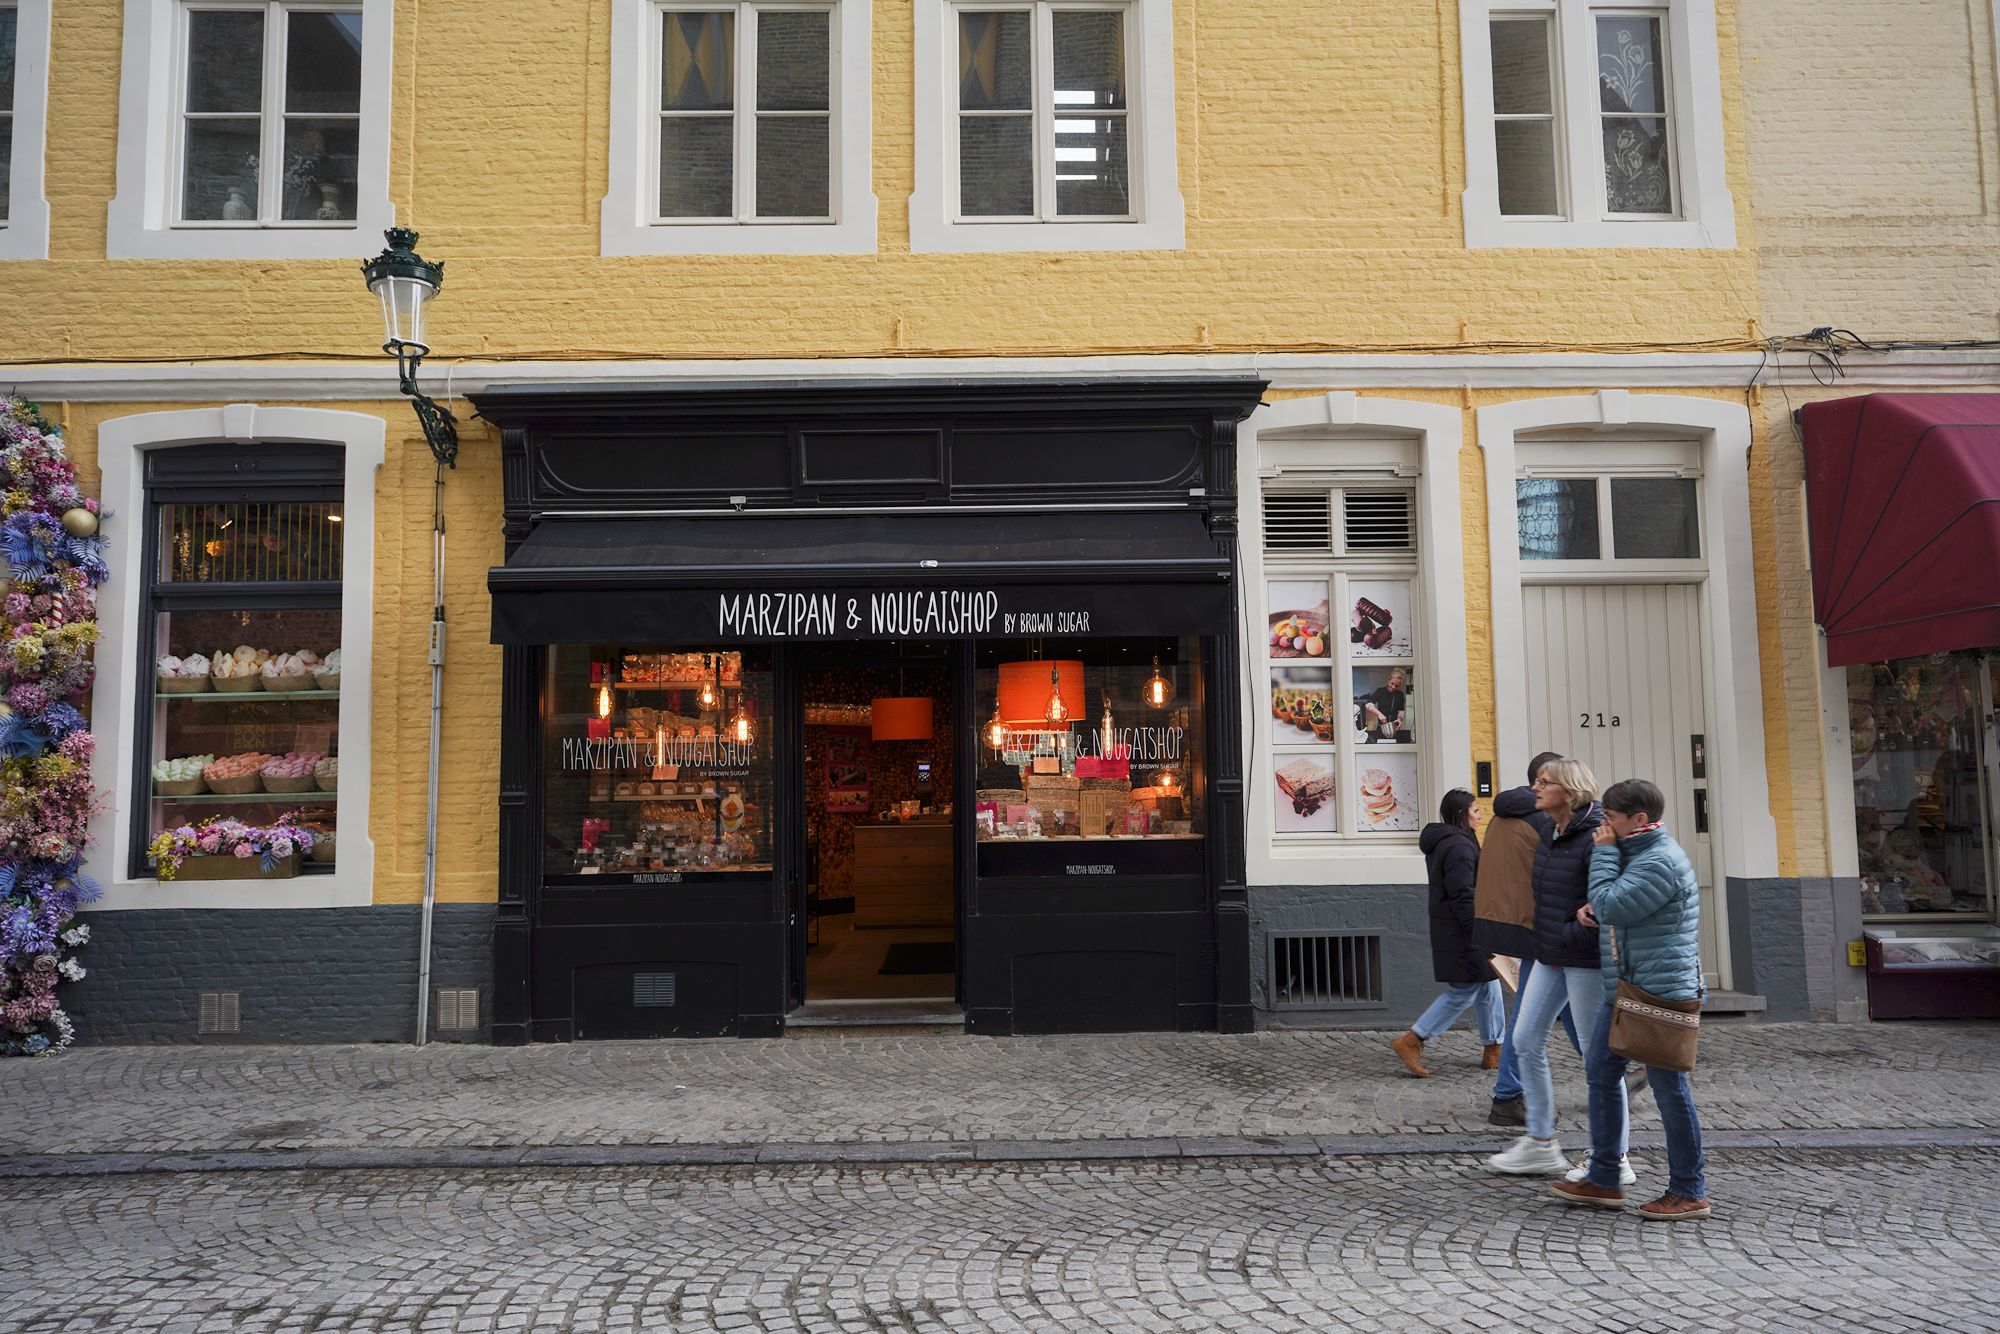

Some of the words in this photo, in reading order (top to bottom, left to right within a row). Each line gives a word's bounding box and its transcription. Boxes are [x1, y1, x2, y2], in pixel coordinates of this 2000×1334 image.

[719, 593, 837, 636] MARZIPAN
[846, 598, 862, 630] &
[871, 590, 998, 635] NOUGATSHOP
[1004, 612, 1016, 634] BY
[1020, 612, 1053, 633] BROWN
[1057, 611, 1091, 633] SUGAR
[1580, 712, 1621, 728] 21a
[562, 736, 638, 770] MARZIPAN
[644, 742, 658, 767] &
[663, 733, 755, 768] NOUGATSHOP
[1075, 734, 1089, 760] &
[1092, 726, 1184, 761] NOUGATSHOP
[730, 769, 750, 777] SUGAR
